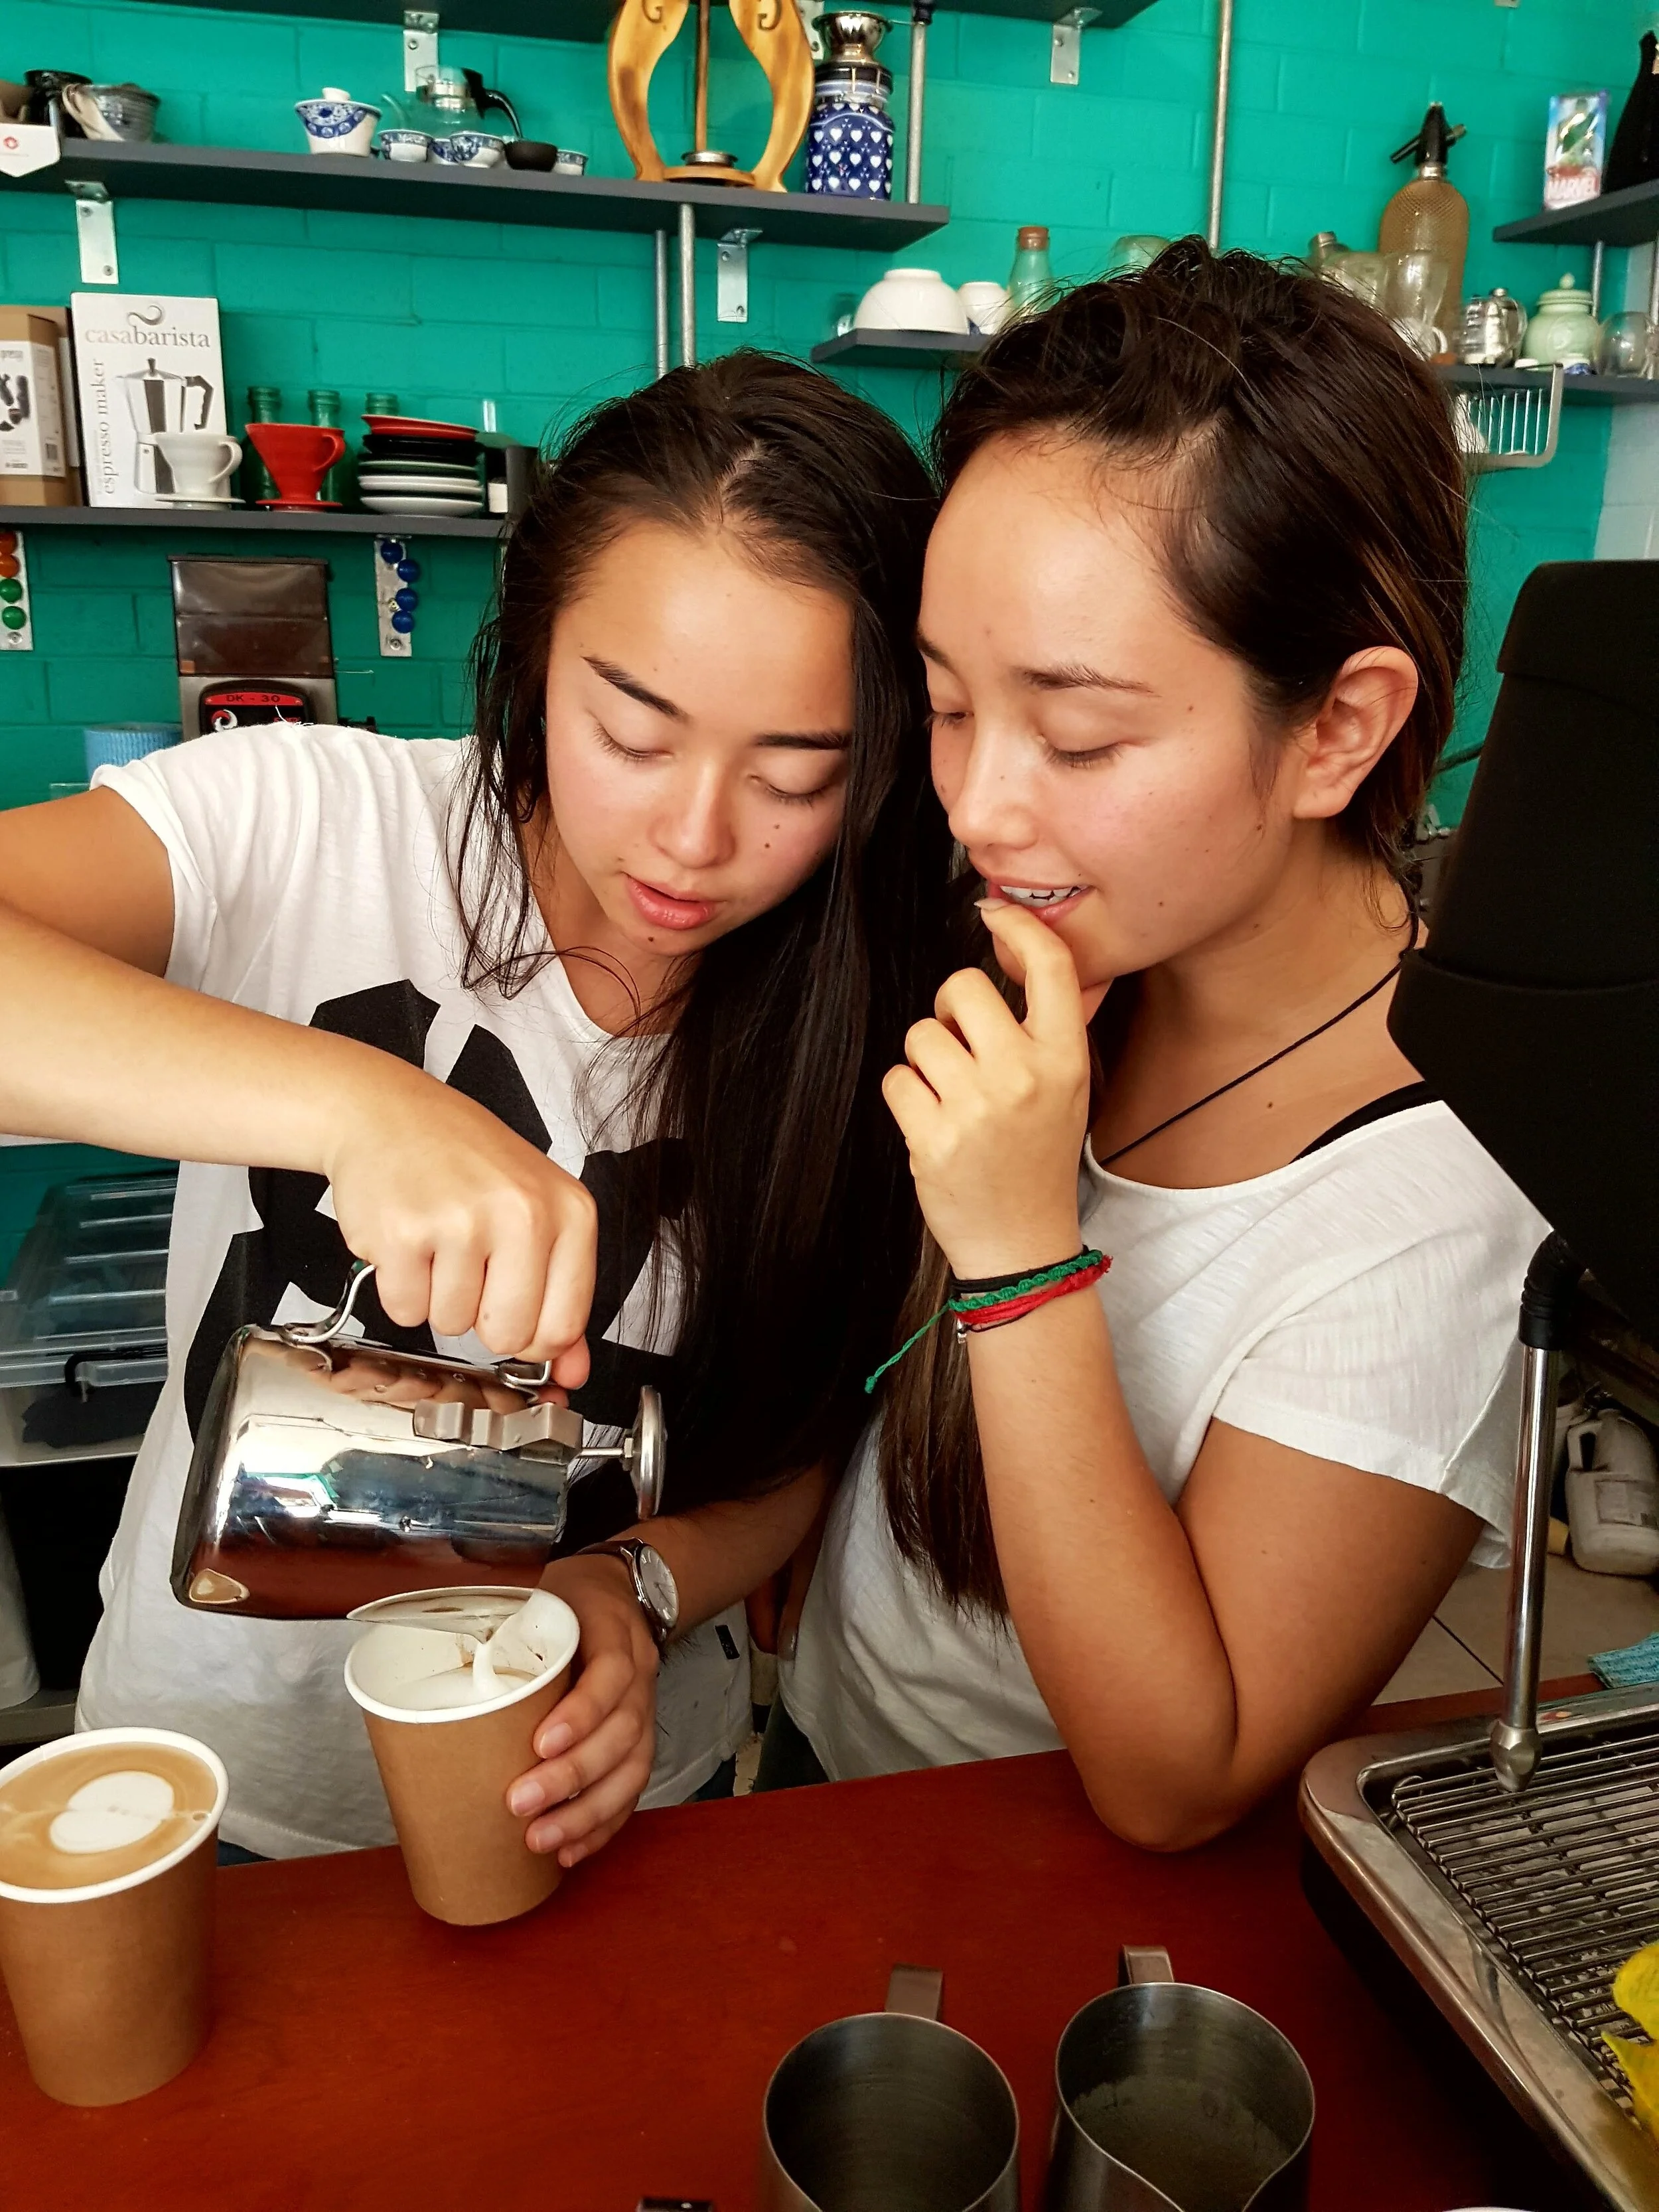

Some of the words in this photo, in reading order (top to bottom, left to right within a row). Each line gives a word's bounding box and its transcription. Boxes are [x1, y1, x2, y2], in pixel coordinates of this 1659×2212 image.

[85, 326, 210, 348] casabarista
[90, 358, 109, 415] maker
[100, 421, 119, 494] espresso
[261, 694, 281, 703] 30
